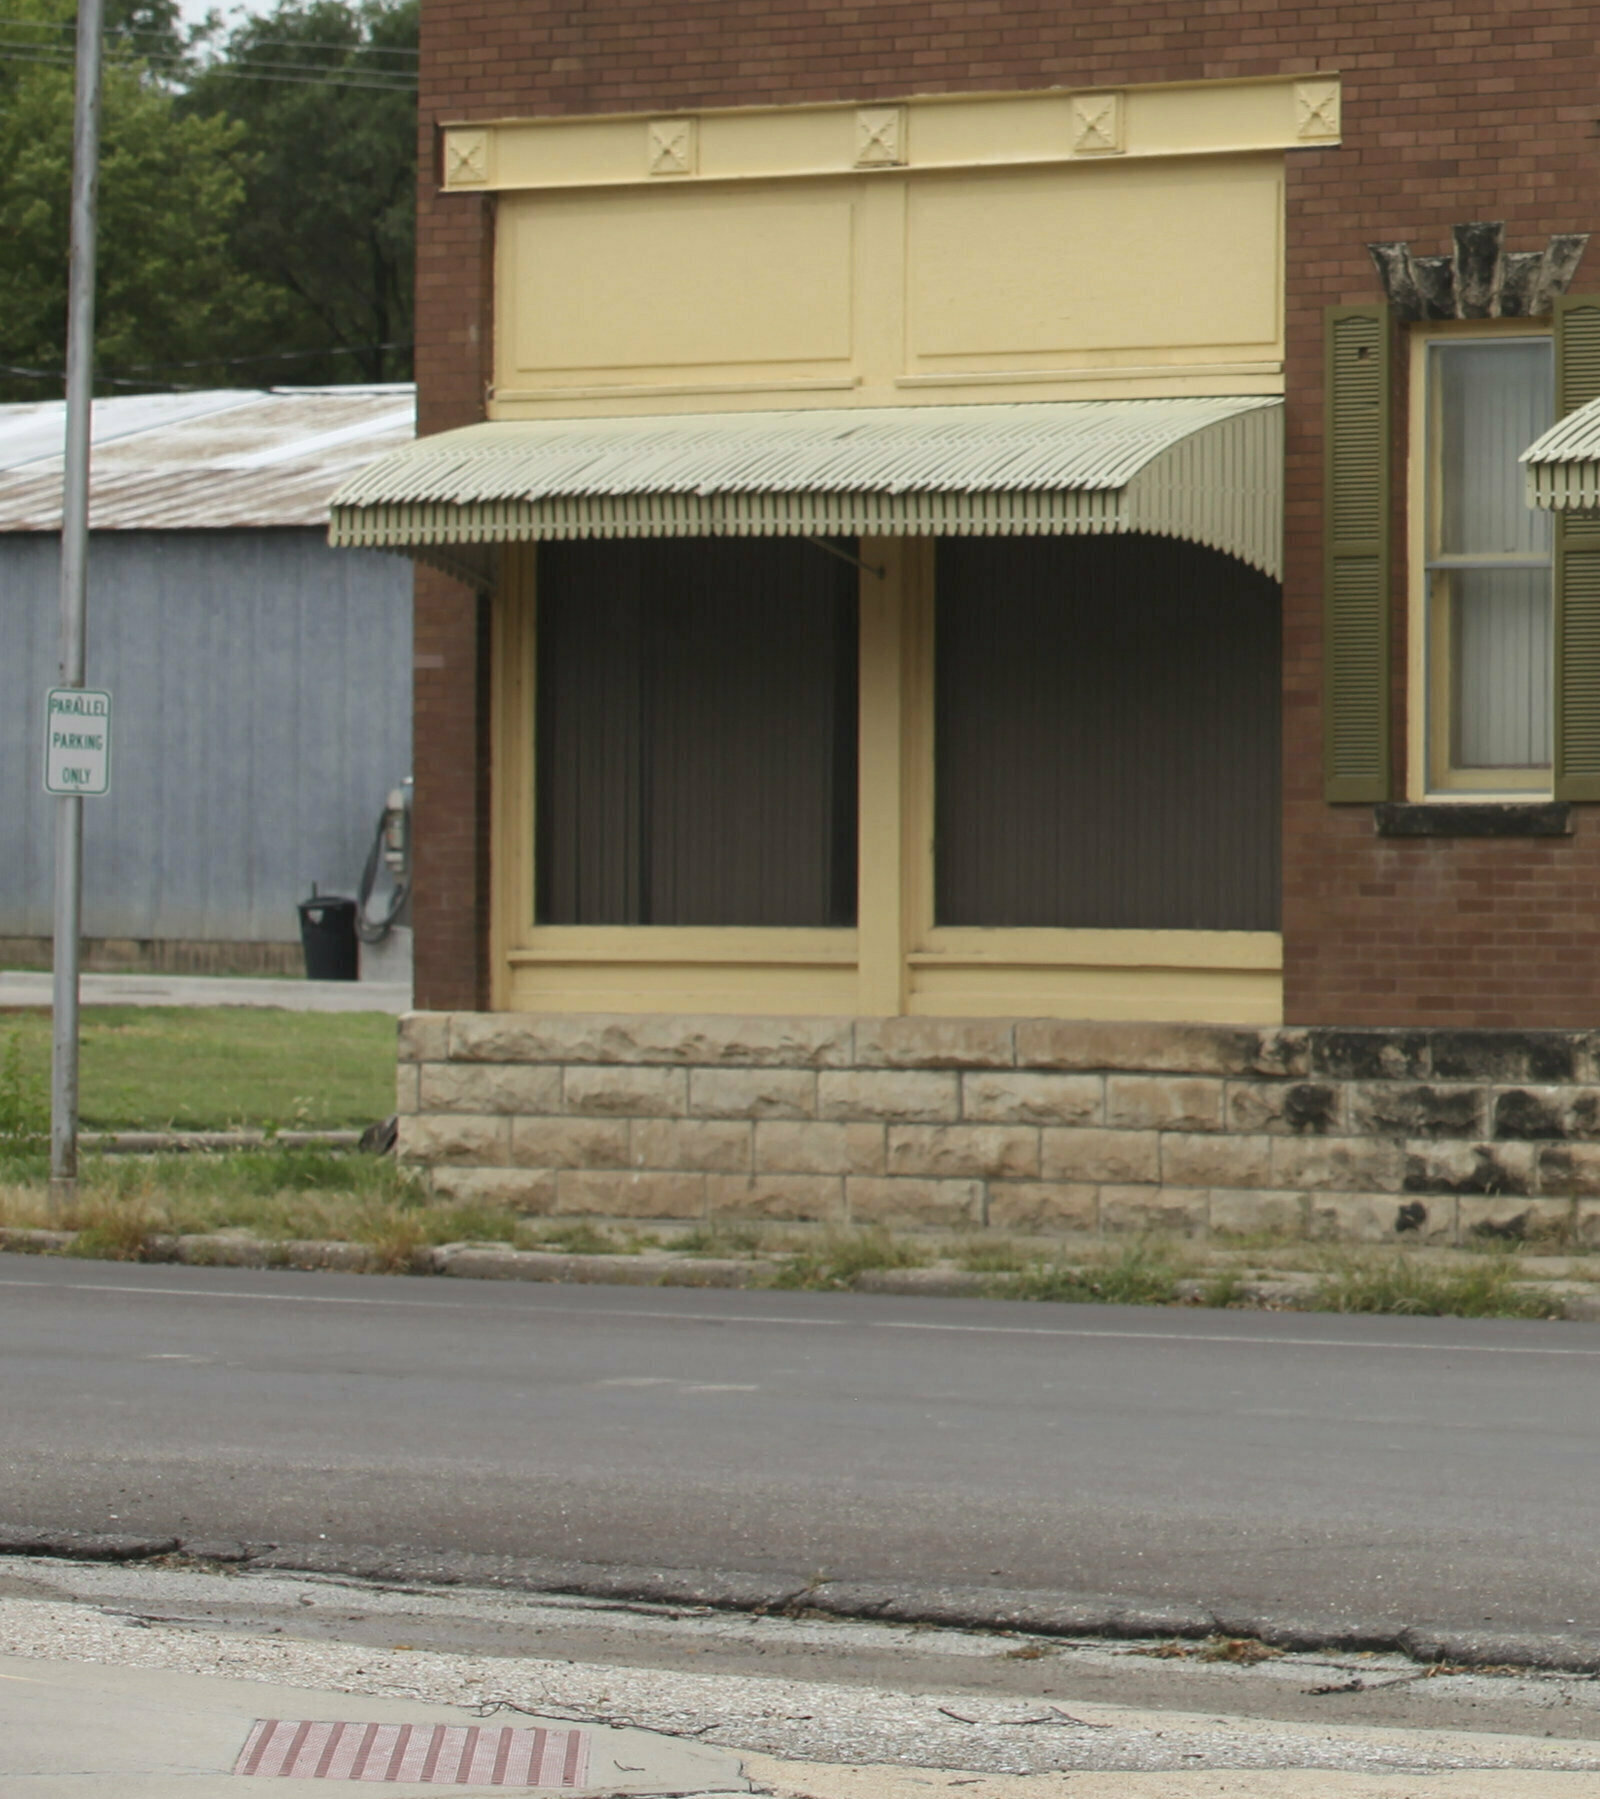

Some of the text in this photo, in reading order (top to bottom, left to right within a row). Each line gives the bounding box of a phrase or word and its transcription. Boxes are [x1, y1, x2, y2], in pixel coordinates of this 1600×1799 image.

[51, 697, 108, 717] PARALLEL
[53, 732, 103, 750] PARKING
[62, 767, 92, 785] ONLY
